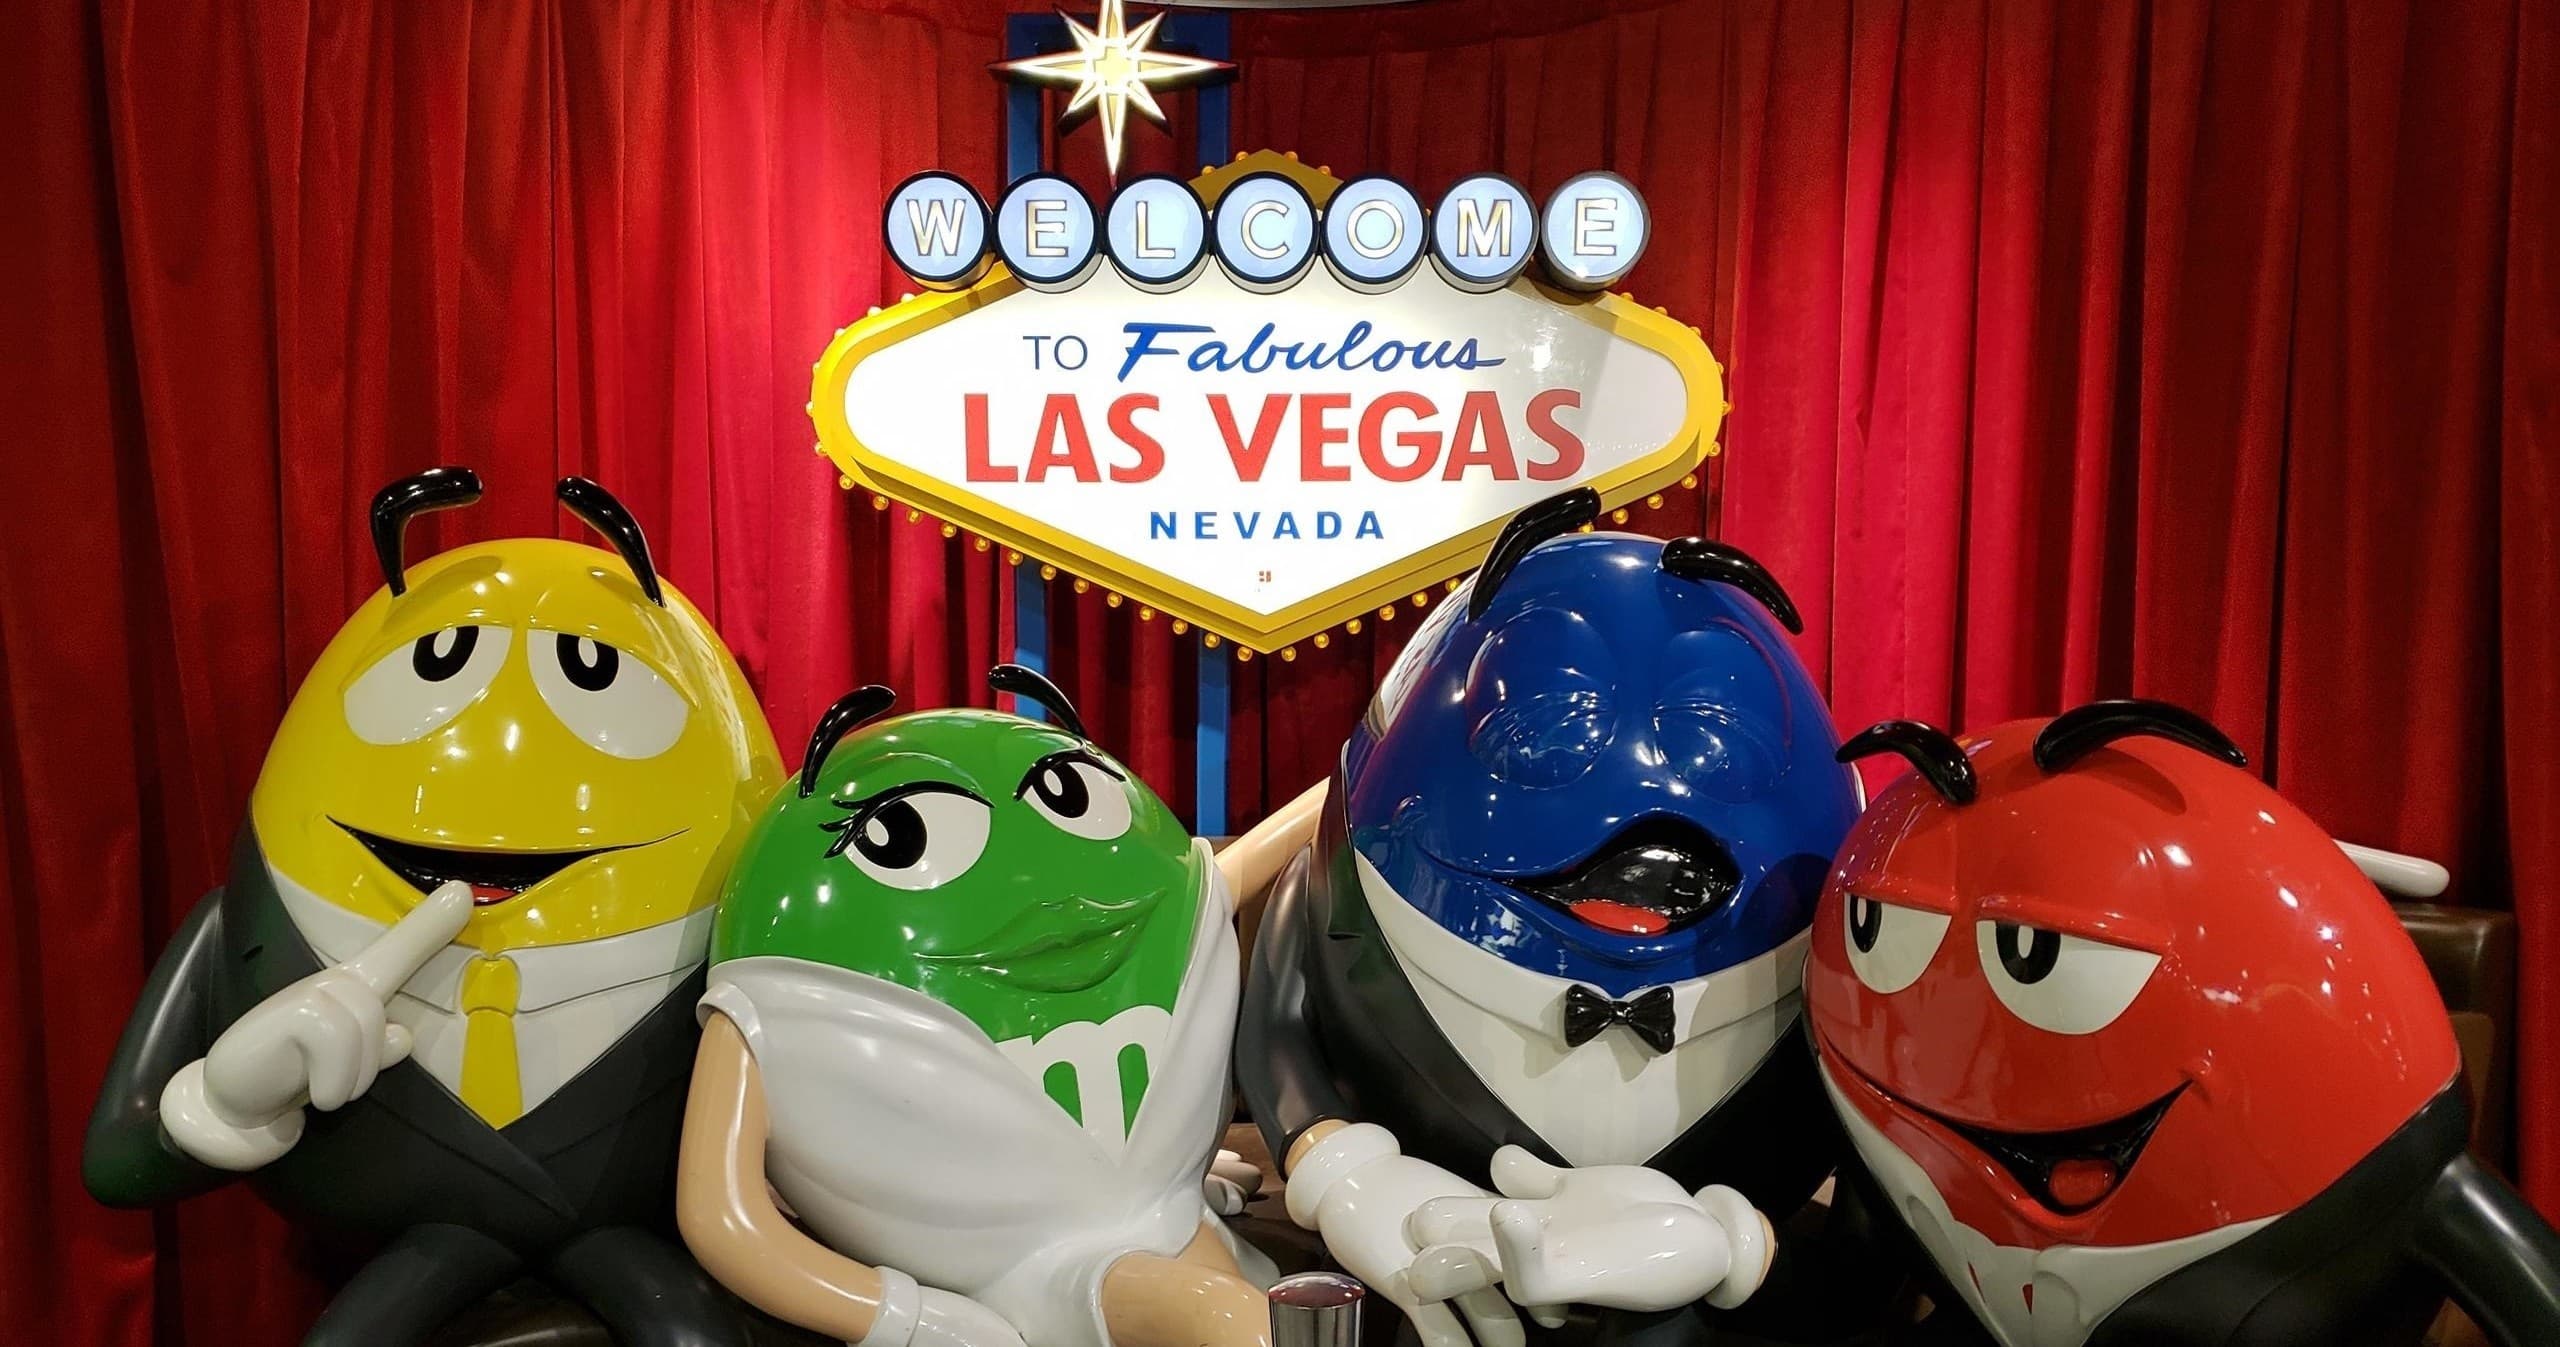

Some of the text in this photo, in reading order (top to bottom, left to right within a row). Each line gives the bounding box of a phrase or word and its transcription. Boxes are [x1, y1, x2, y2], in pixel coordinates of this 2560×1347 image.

[906, 197, 1618, 259] WELCOME
[1022, 321, 1506, 382] TO Fabulous
[964, 390, 1585, 483] LAS VEGAS
[1150, 511, 1385, 540] NEVADA
